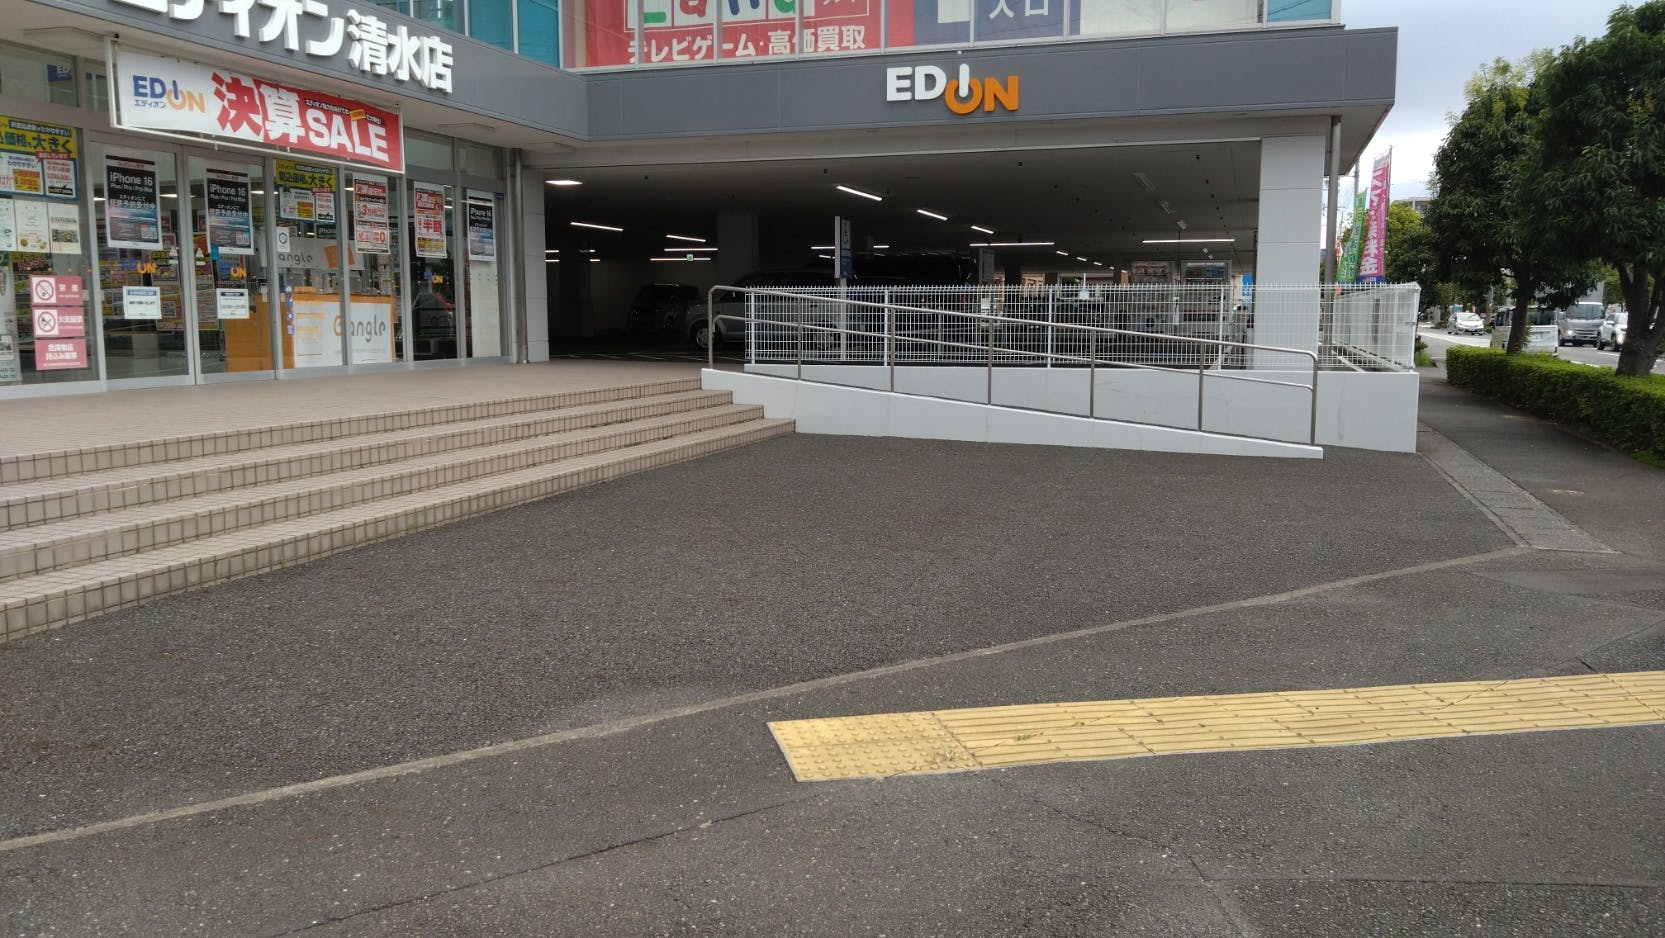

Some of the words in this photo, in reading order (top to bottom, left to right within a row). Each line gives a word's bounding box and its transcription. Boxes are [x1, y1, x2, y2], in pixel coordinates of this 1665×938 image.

[132, 74, 207, 113] EDION
[886, 63, 1019, 115] EDION
[134, 99, 167, 109] エディオン
[110, 171, 142, 185] iPhone
[143, 176, 153, 186] 16
[209, 183, 236, 195] iPhone
[238, 187, 246, 197] 16
